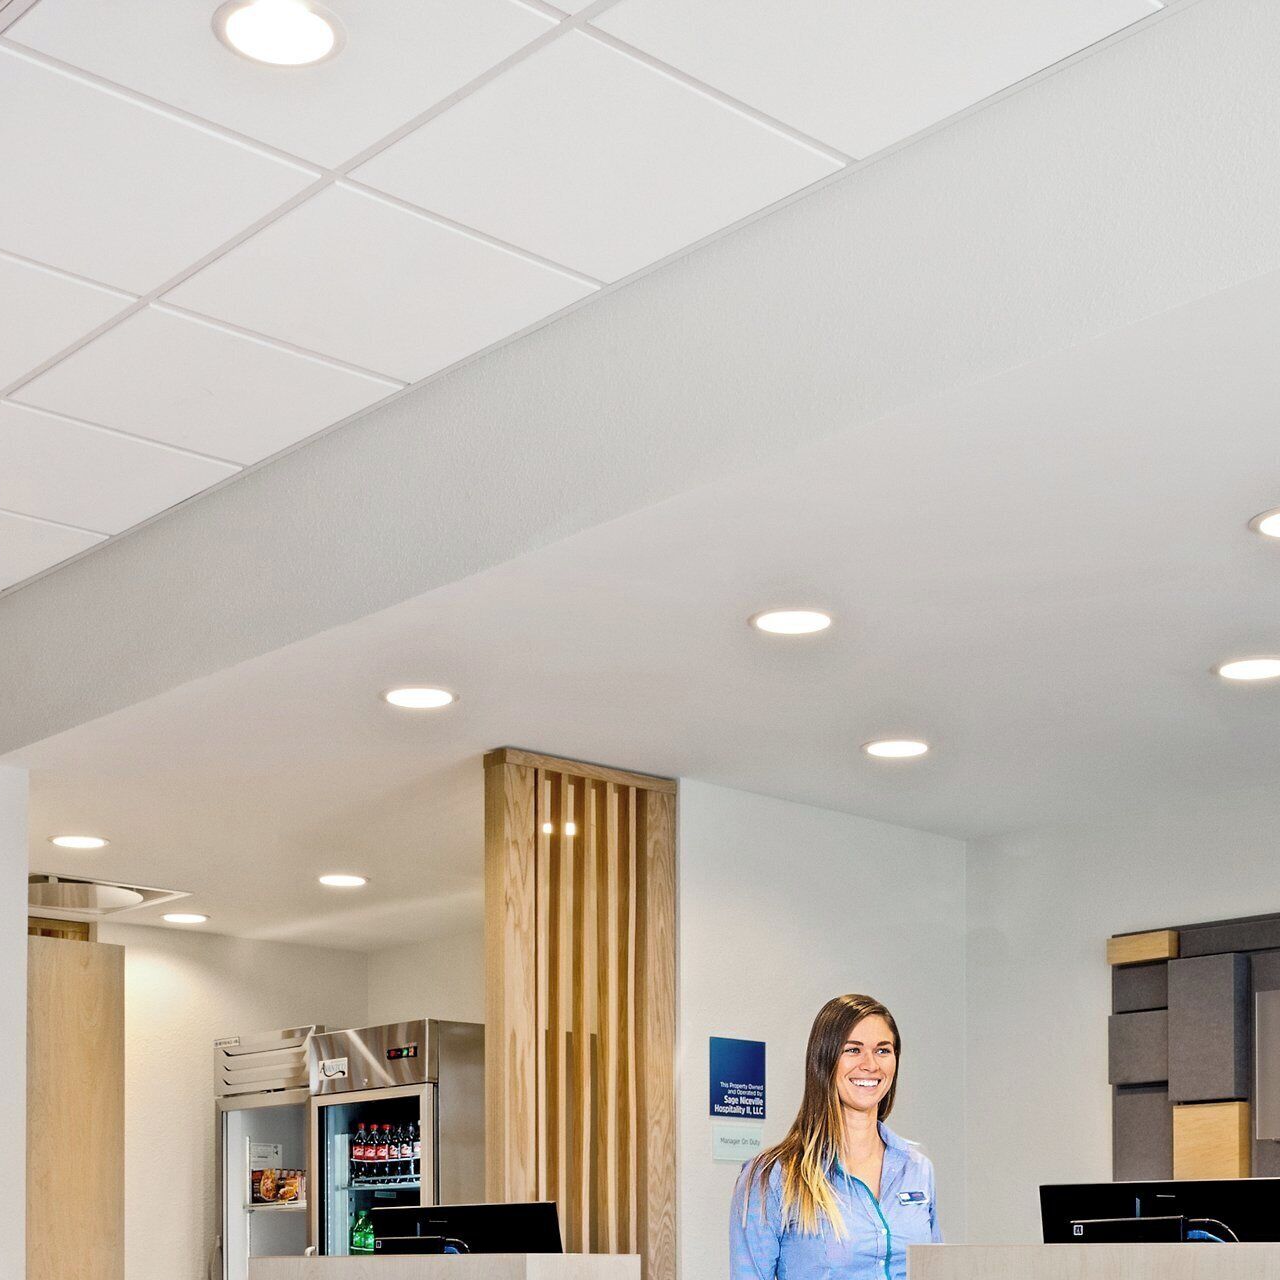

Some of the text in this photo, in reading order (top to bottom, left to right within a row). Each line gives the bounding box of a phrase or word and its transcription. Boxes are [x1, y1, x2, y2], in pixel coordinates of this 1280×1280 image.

[724, 1095, 764, 1106] Sage Niceville
[714, 1104, 746, 1115] Hospitality
[752, 1106, 764, 1116] LLC
[720, 1137, 740, 1146] Manager
